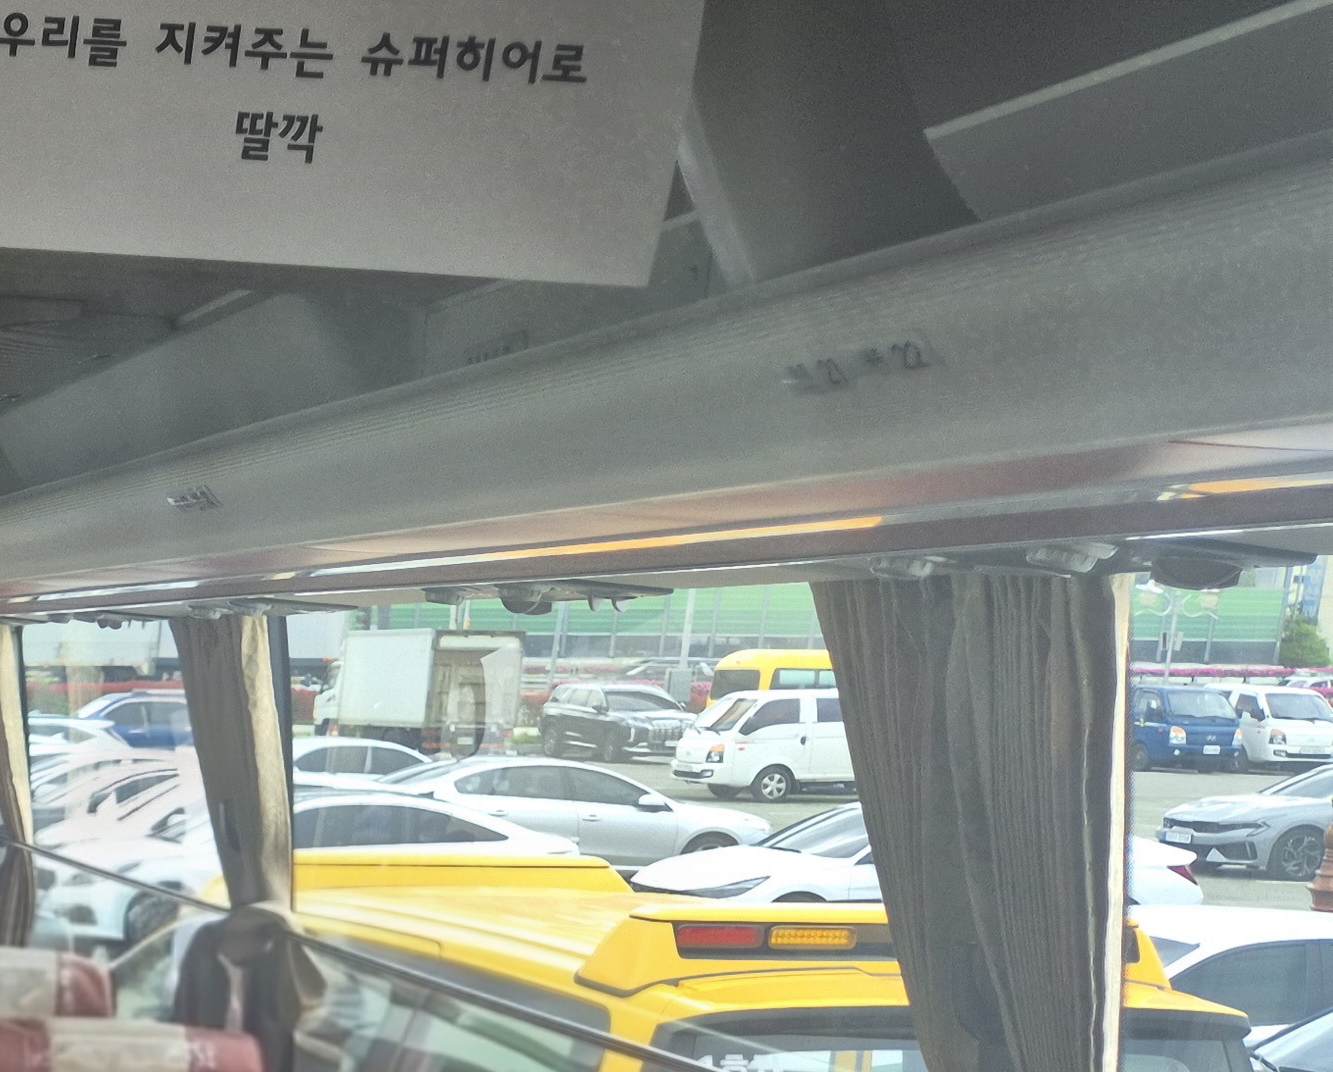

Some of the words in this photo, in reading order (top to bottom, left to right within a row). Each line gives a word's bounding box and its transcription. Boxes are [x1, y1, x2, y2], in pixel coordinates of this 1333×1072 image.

[155, 22, 333, 79] 지켜주는
[361, 32, 587, 84] 슈퍼히어로
[235, 110, 323, 164] 딸깍
